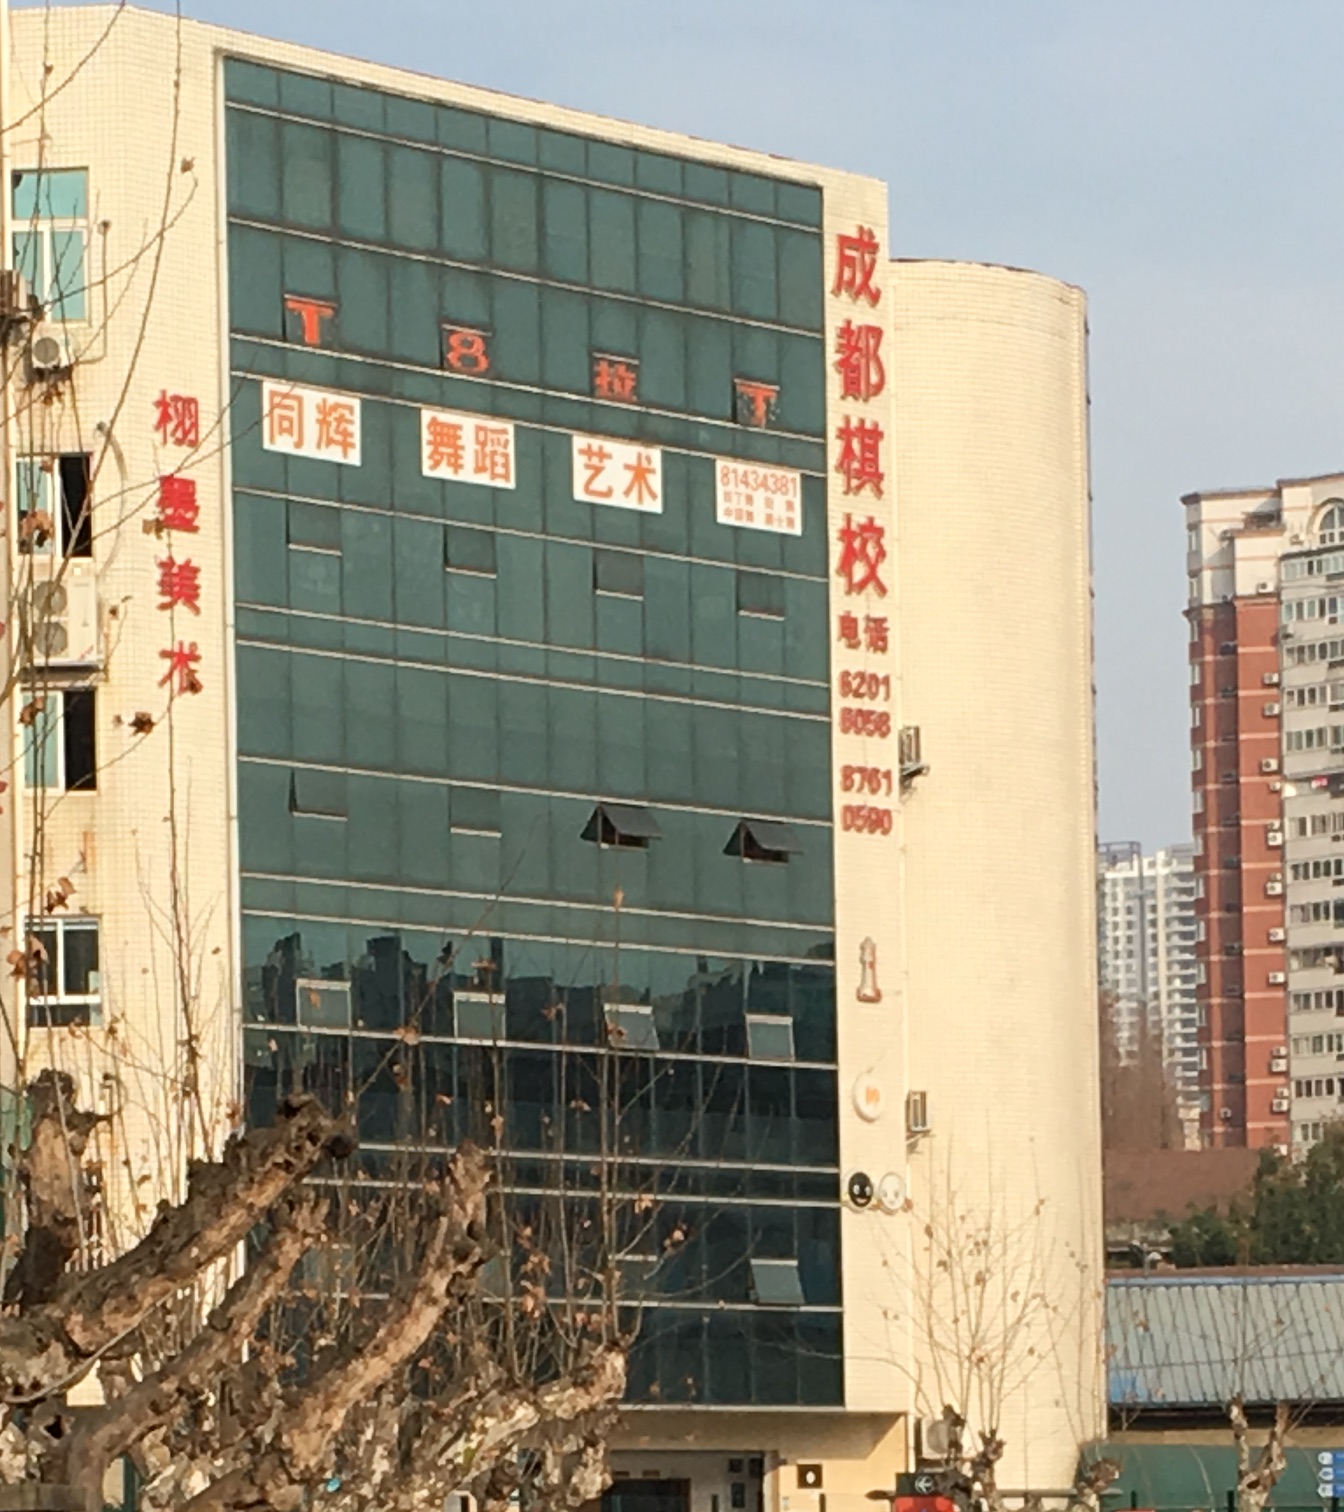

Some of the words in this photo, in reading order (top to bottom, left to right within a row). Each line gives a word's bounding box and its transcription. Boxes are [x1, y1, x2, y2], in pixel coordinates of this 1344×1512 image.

[268, 390, 357, 459] 同辉
[426, 416, 512, 483] 舞蹈
[578, 443, 658, 505] 艺术
[830, 224, 888, 598] 成都棋校
[153, 389, 203, 696] 栩墨美术
[837, 611, 890, 654] 电话
